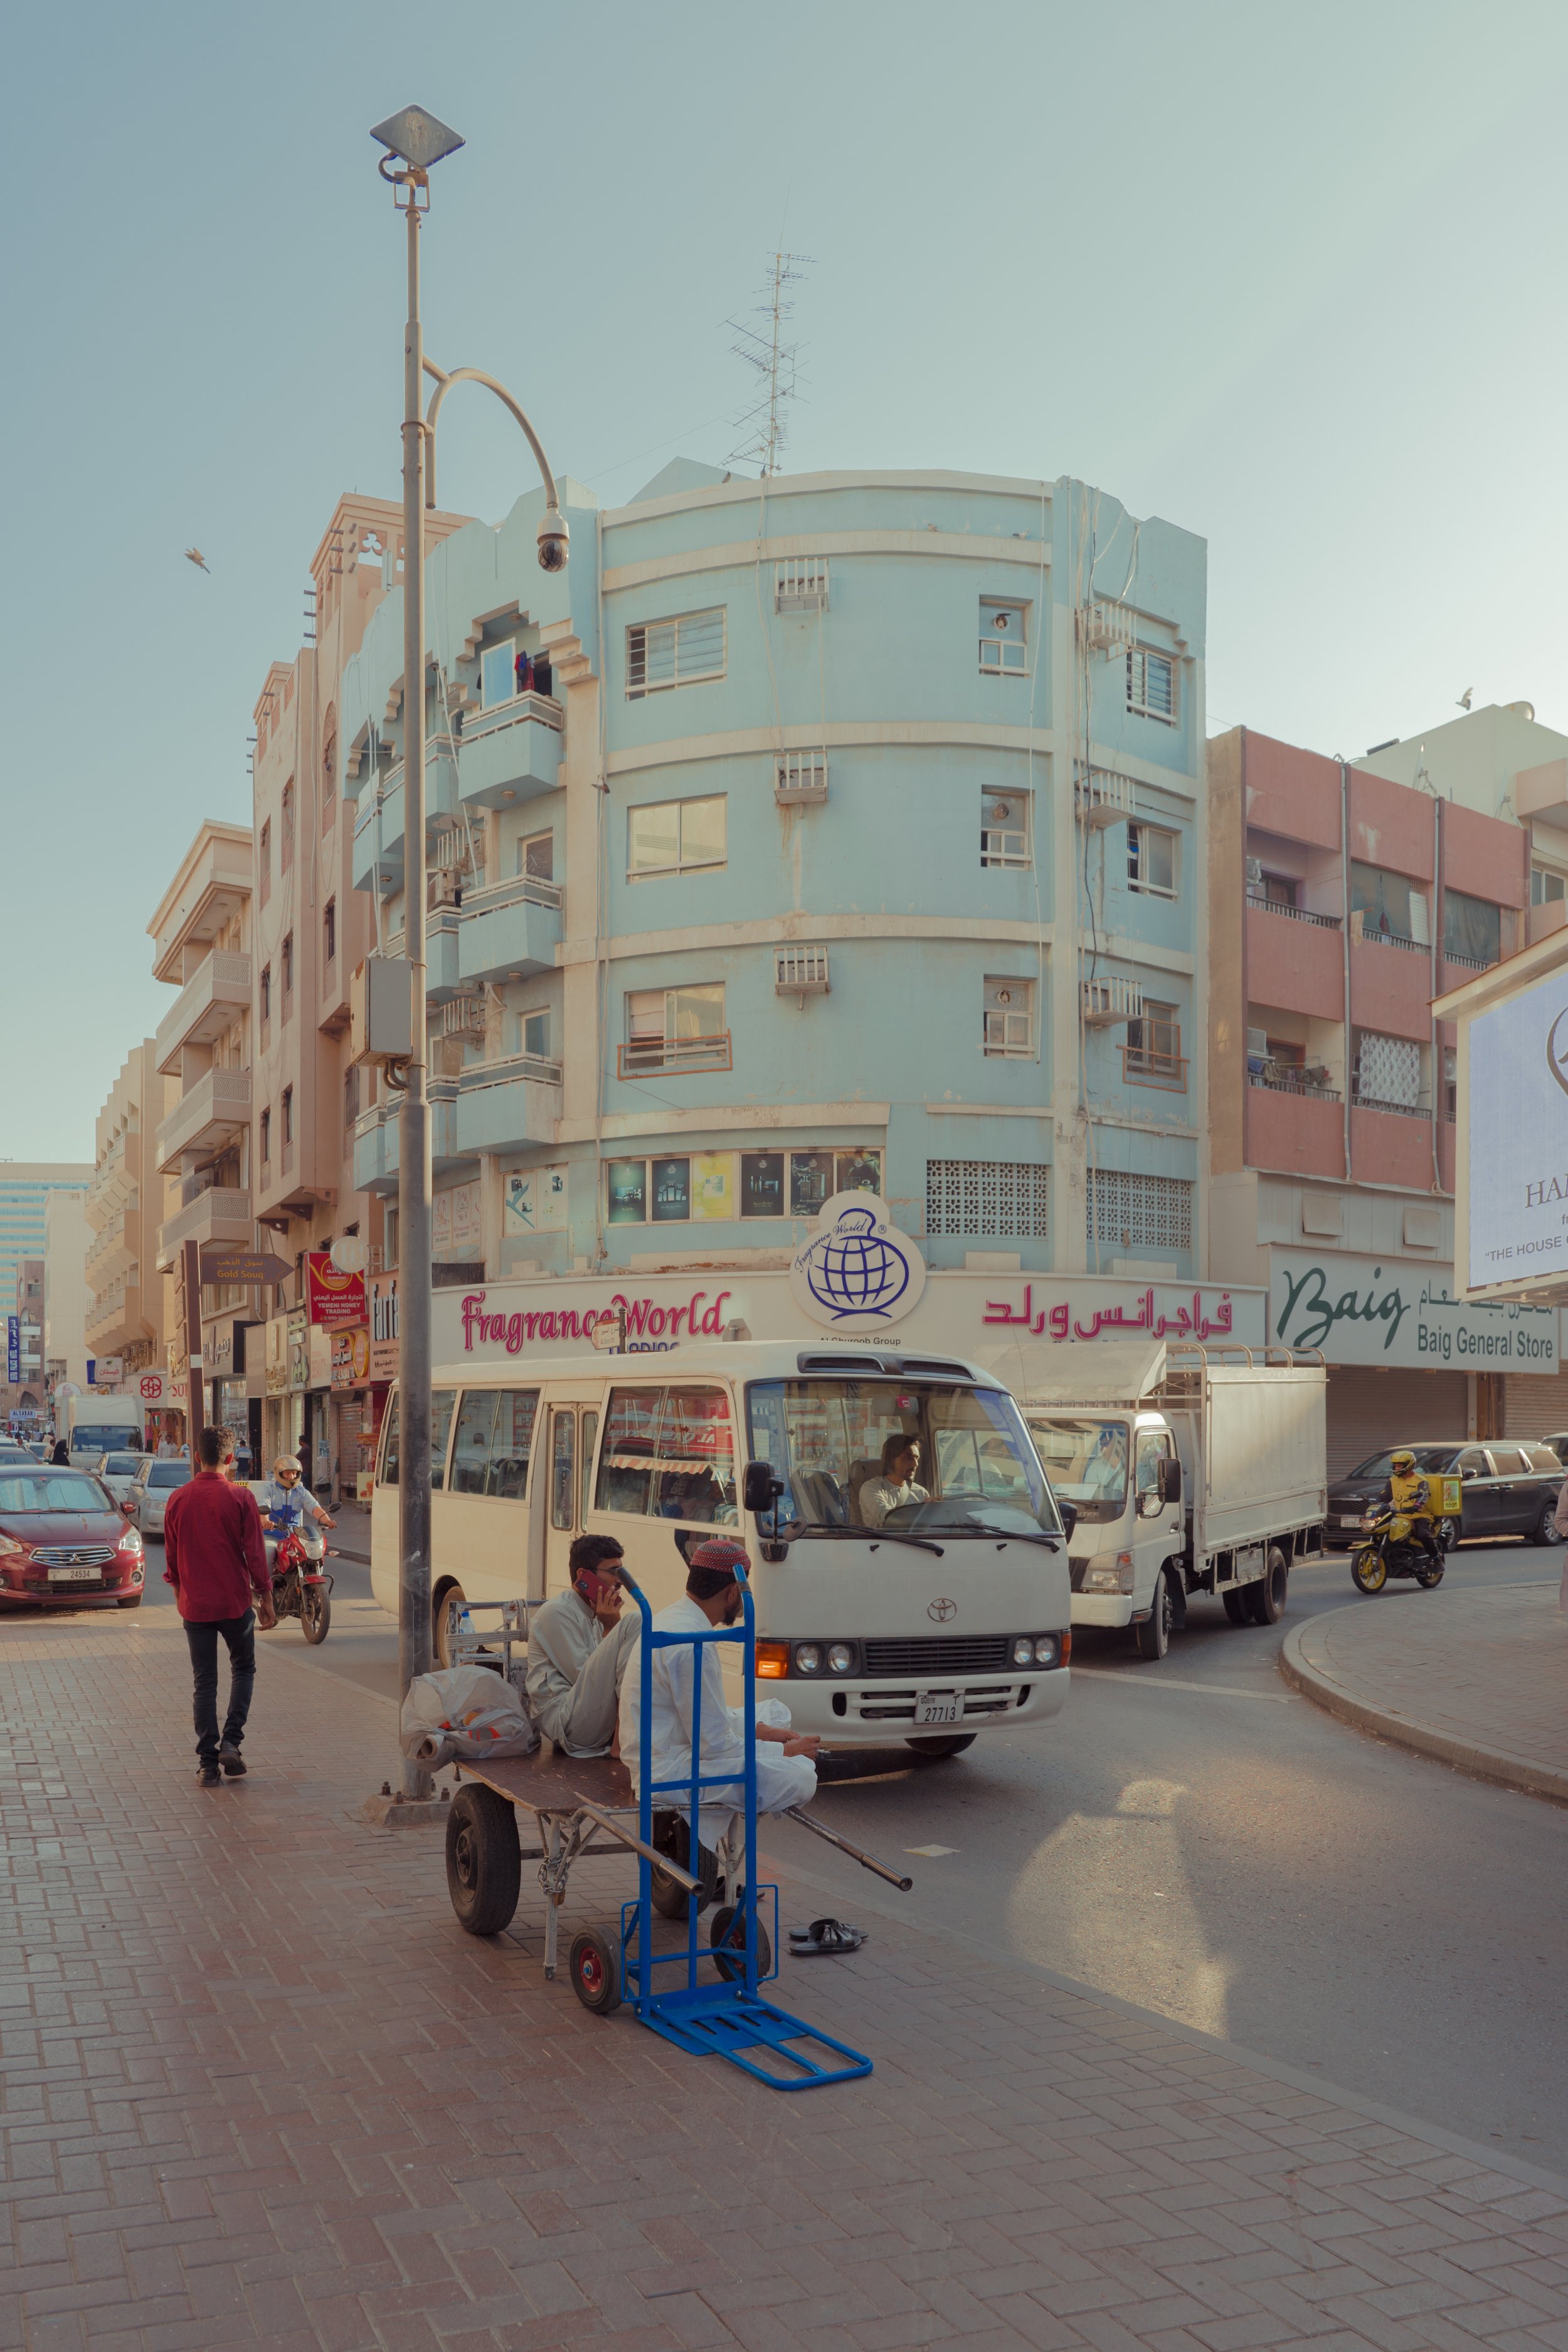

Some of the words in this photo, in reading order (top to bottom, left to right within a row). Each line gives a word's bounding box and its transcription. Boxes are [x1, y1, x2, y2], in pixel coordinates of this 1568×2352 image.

[1525, 1173, 1568, 1209] HA
[794, 1232, 831, 1273] Fragrance
[832, 1217, 868, 1236] World
[1517, 1236, 1562, 1256] HOUSE
[217, 1258, 240, 1266] الذهب
[217, 1269, 238, 1278] Gold
[241, 1270, 263, 1279] Souq
[612, 1291, 733, 1337] World
[982, 1283, 1069, 1339] ورلد
[1074, 1286, 1233, 1340] فراجرانس
[1276, 1266, 1411, 1354] Baig
[873, 1337, 901, 1347] Group
[1417, 1323, 1451, 1360] Baig
[1457, 1327, 1512, 1356] General
[1517, 1330, 1553, 1359] Store
[172, 1384, 188, 1397] SU
[71, 1570, 90, 1578] 24534
[924, 1707, 956, 1721] 27713
